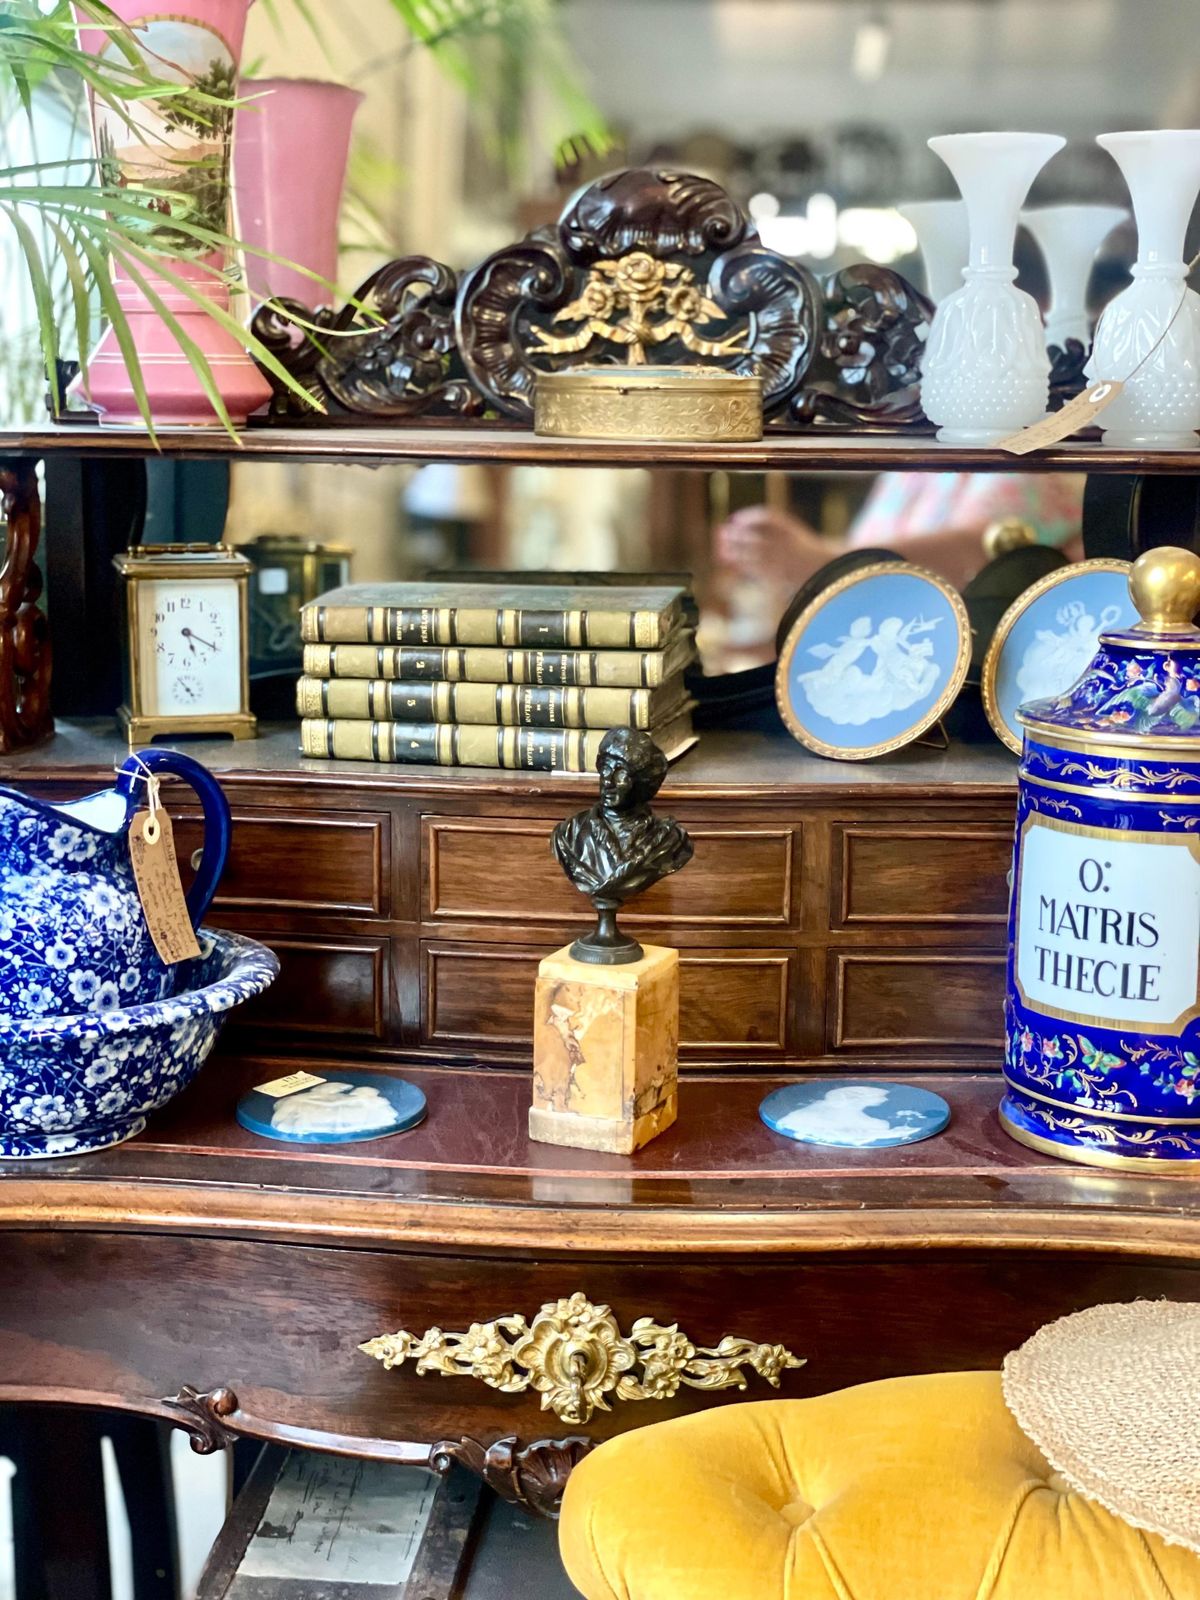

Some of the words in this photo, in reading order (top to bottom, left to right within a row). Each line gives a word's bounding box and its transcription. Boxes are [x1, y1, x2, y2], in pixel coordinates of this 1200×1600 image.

[167, 601, 175, 613] 11
[180, 598, 191, 609] 12
[154, 613, 165, 624] 10
[209, 612, 218, 624] 2
[150, 627, 158, 638] 9
[167, 652, 175, 666] 7
[1038, 894, 1159, 948] MATRIS
[1034, 945, 1161, 1002] THECLE
